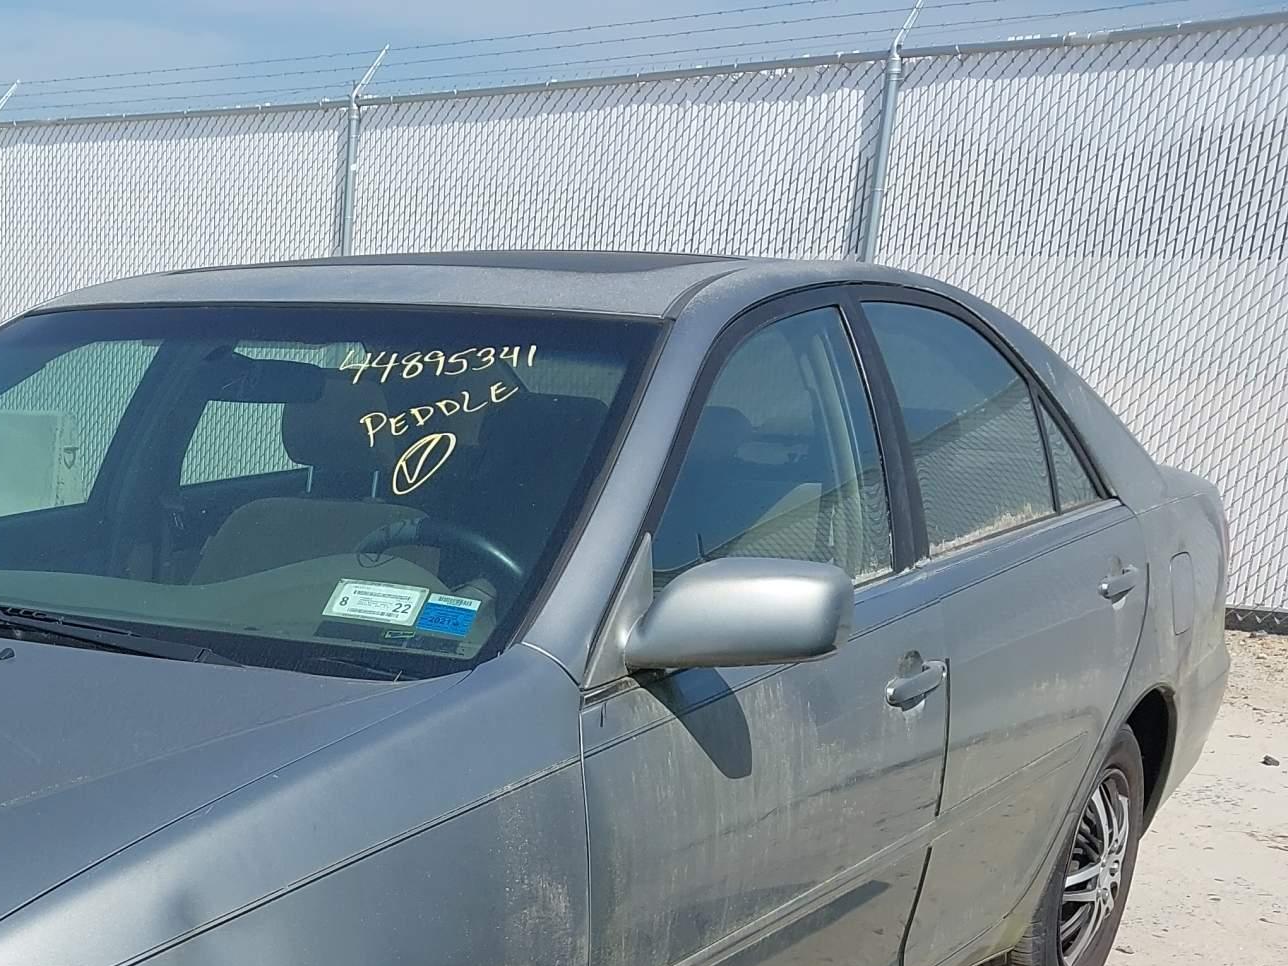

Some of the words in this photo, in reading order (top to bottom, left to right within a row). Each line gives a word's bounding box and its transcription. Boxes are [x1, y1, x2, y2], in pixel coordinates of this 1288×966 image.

[338, 344, 538, 385] 44895341
[359, 381, 520, 448] PEDDLE
[339, 595, 350, 607] 8
[391, 602, 412, 615] 22
